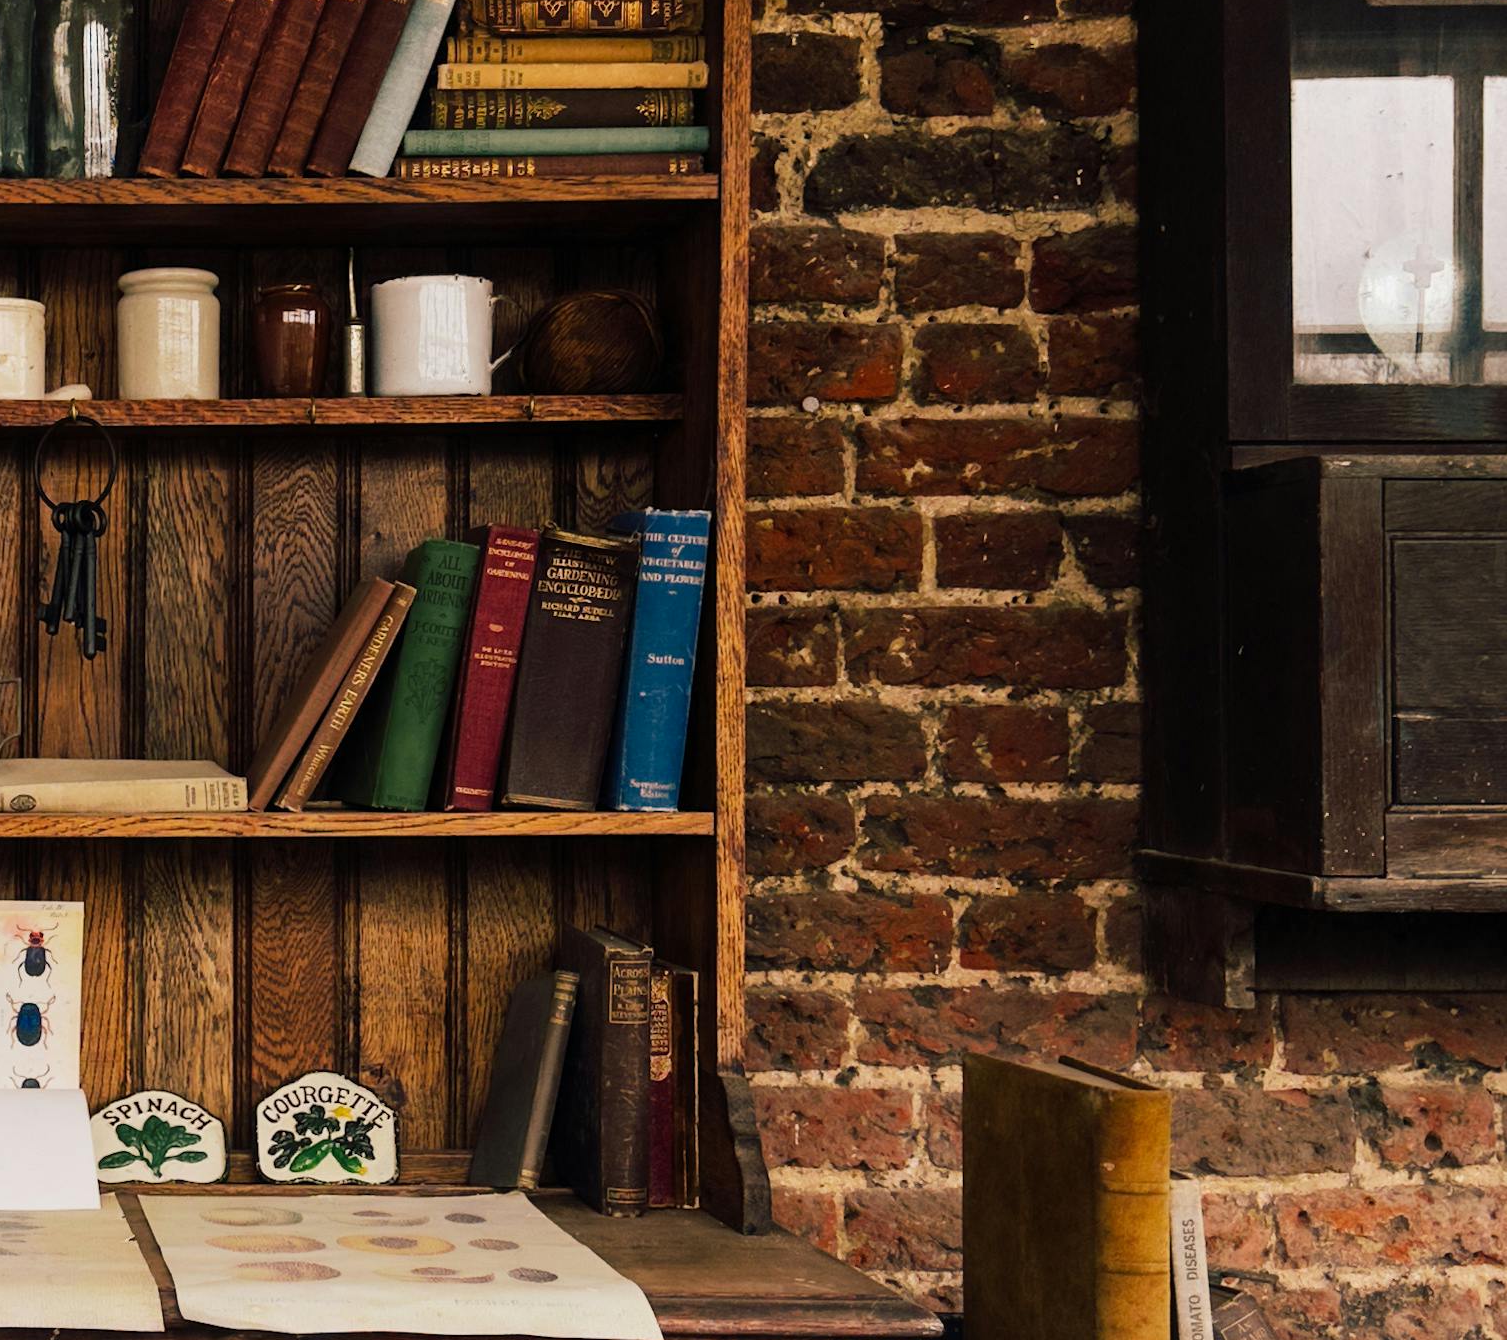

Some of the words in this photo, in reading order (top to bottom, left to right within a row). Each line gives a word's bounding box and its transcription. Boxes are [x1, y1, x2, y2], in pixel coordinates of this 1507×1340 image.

[644, 532, 665, 543] THE
[671, 544, 685, 558] of
[439, 555, 462, 572] ALL
[425, 569, 469, 591] ABOUT
[486, 567, 530, 581] GARDENING
[546, 566, 619, 586] GARDENING
[641, 572, 662, 582] AND
[541, 601, 581, 613] RICHARD
[582, 605, 615, 618] SUDELL
[647, 653, 685, 666] Sutton
[330, 688, 358, 731] EARTH
[639, 787, 669, 799] Edition
[614, 966, 649, 978] ACROSS
[613, 984, 647, 996] PLAINS
[102, 1098, 213, 1131] SPINACH
[262, 1086, 394, 1130] COURGETTE
[1183, 1218, 1198, 1281] DISEASES
[1237, 1323, 1252, 1334] AN
